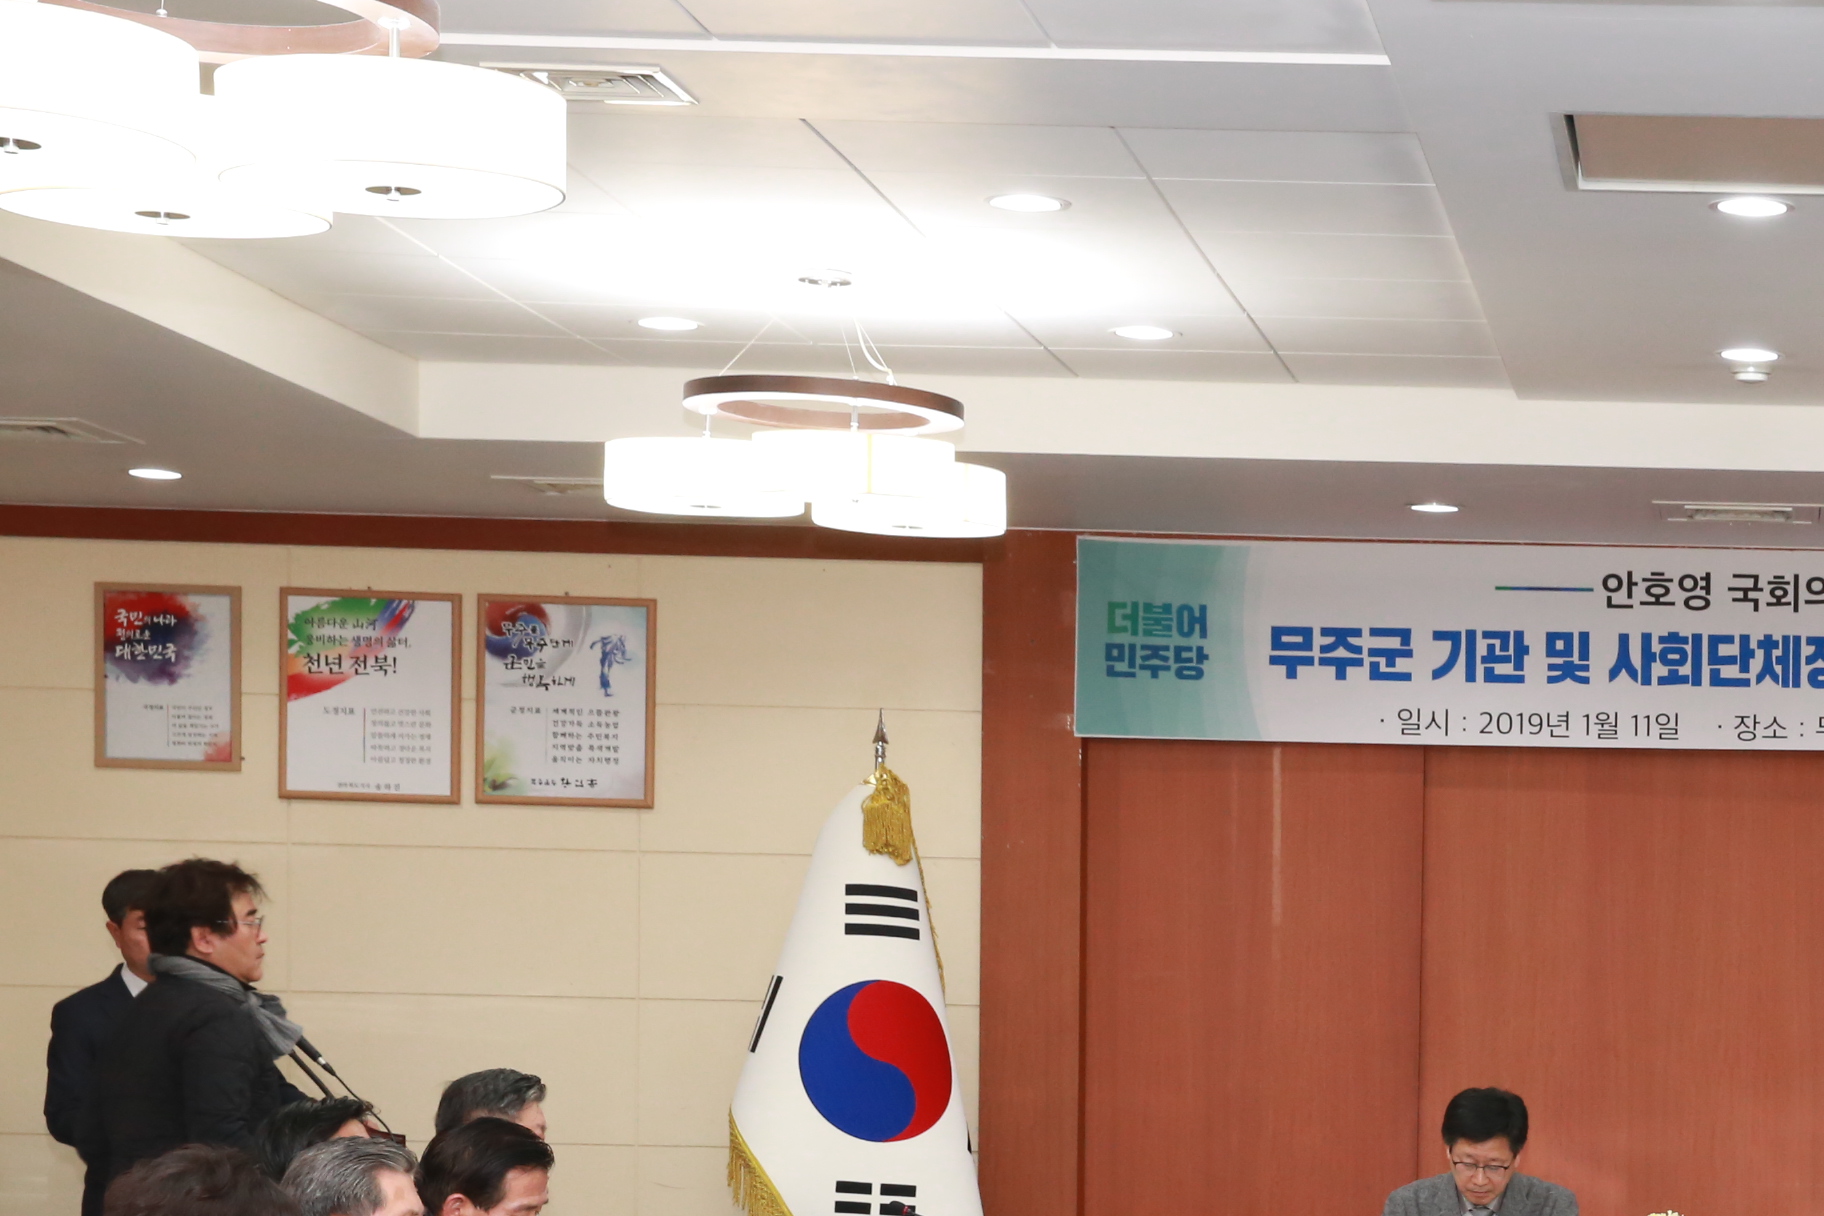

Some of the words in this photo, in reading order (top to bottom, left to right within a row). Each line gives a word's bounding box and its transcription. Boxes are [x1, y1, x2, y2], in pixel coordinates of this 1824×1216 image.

[1602, 570, 1711, 611] 안호영
[304, 616, 349, 630] 아름다운
[1107, 601, 1208, 638] 더불어
[115, 642, 177, 662] 대한민국
[351, 635, 384, 648] 생명의
[1269, 626, 1413, 682] 무주군
[1432, 629, 1529, 684] 기관
[1545, 631, 1590, 685] 및
[303, 652, 344, 675] 천년
[350, 653, 397, 677] 전북!
[1105, 643, 1209, 680] 민주당
[1397, 708, 1449, 736] 일시
[1479, 710, 1570, 739] 2019년
[1582, 711, 1619, 740] 1월
[1630, 712, 1679, 740] 11일
[1734, 713, 1788, 742] 장소
